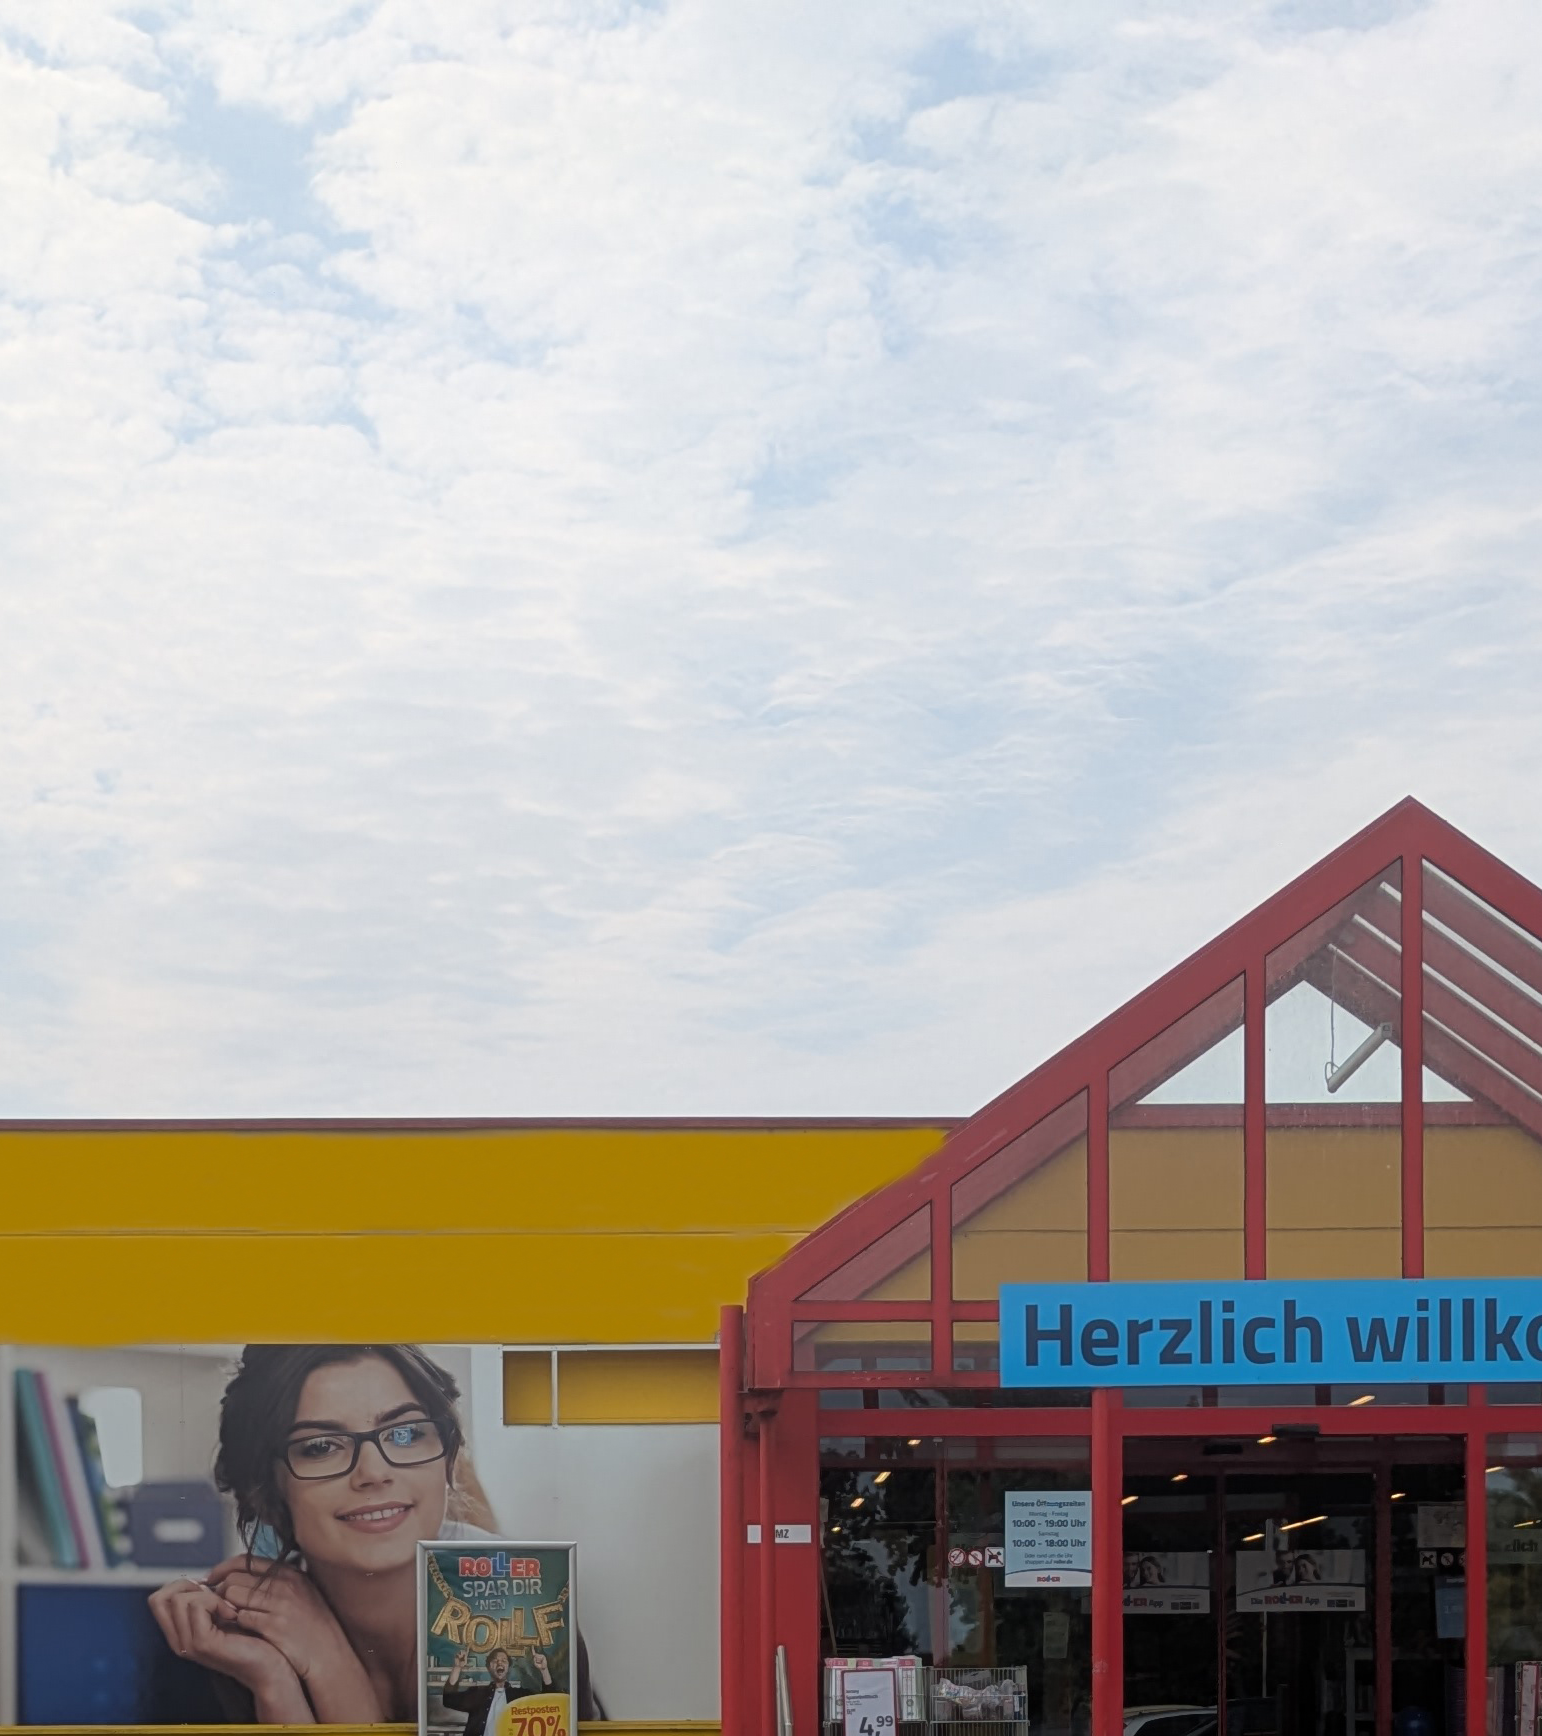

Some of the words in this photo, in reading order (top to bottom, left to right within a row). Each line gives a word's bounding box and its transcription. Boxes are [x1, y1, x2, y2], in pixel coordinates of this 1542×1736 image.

[1024, 1299, 1323, 1367] Herzlich
[1012, 1519, 1036, 1527] 10:00
[1045, 1519, 1068, 1527] 19:00
[1070, 1519, 1086, 1527] Uhr
[775, 1529, 789, 1538] MZ
[1012, 1539, 1036, 1547] 10:00
[1045, 1539, 1068, 1547] 18:00
[1070, 1539, 1086, 1547] Uhr
[459, 1552, 541, 1578] ROLLER
[463, 1580, 509, 1597] SPAR
[512, 1579, 542, 1595] DIR
[511, 1705, 560, 1716] Restposten
